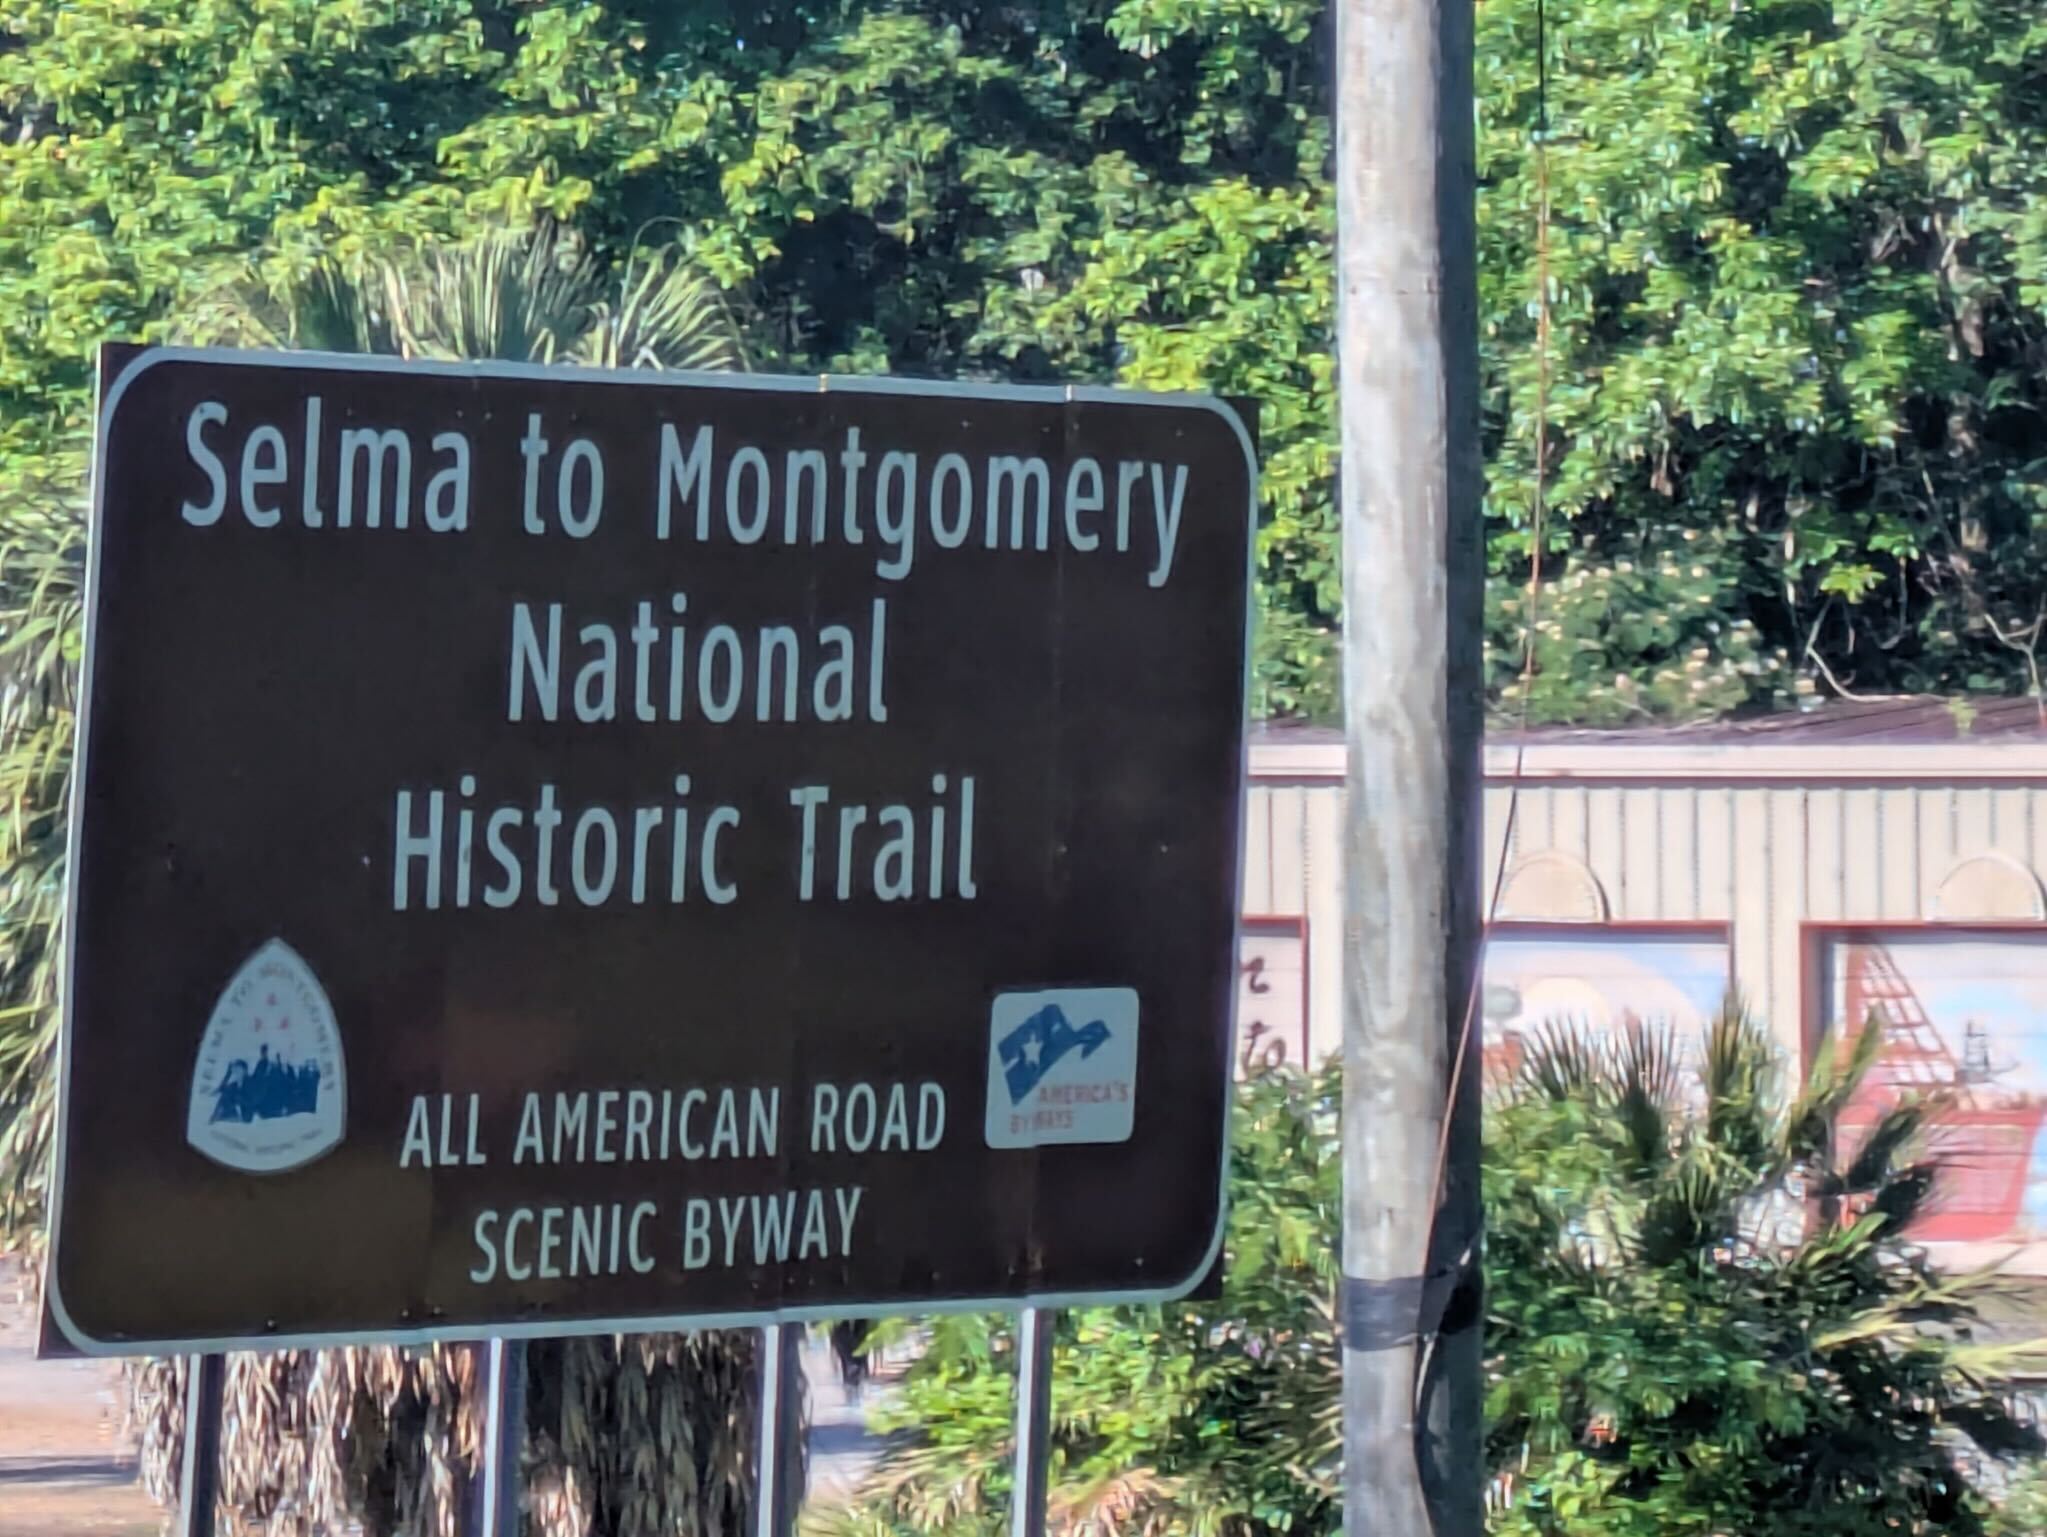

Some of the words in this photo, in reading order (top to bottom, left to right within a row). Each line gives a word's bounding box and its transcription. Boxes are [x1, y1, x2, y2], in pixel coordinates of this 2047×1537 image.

[181, 397, 470, 532] Selma
[520, 413, 604, 538] to
[656, 422, 1190, 588] Montgomery
[508, 593, 888, 723] National
[393, 774, 741, 910] Historic
[790, 773, 978, 902] Trail
[399, 1093, 487, 1168] ALL
[513, 1087, 780, 1164] AMERICAN
[811, 1082, 946, 1152] ROAD
[469, 1201, 657, 1283] SCENIC
[683, 1187, 863, 1270] BYWAY
